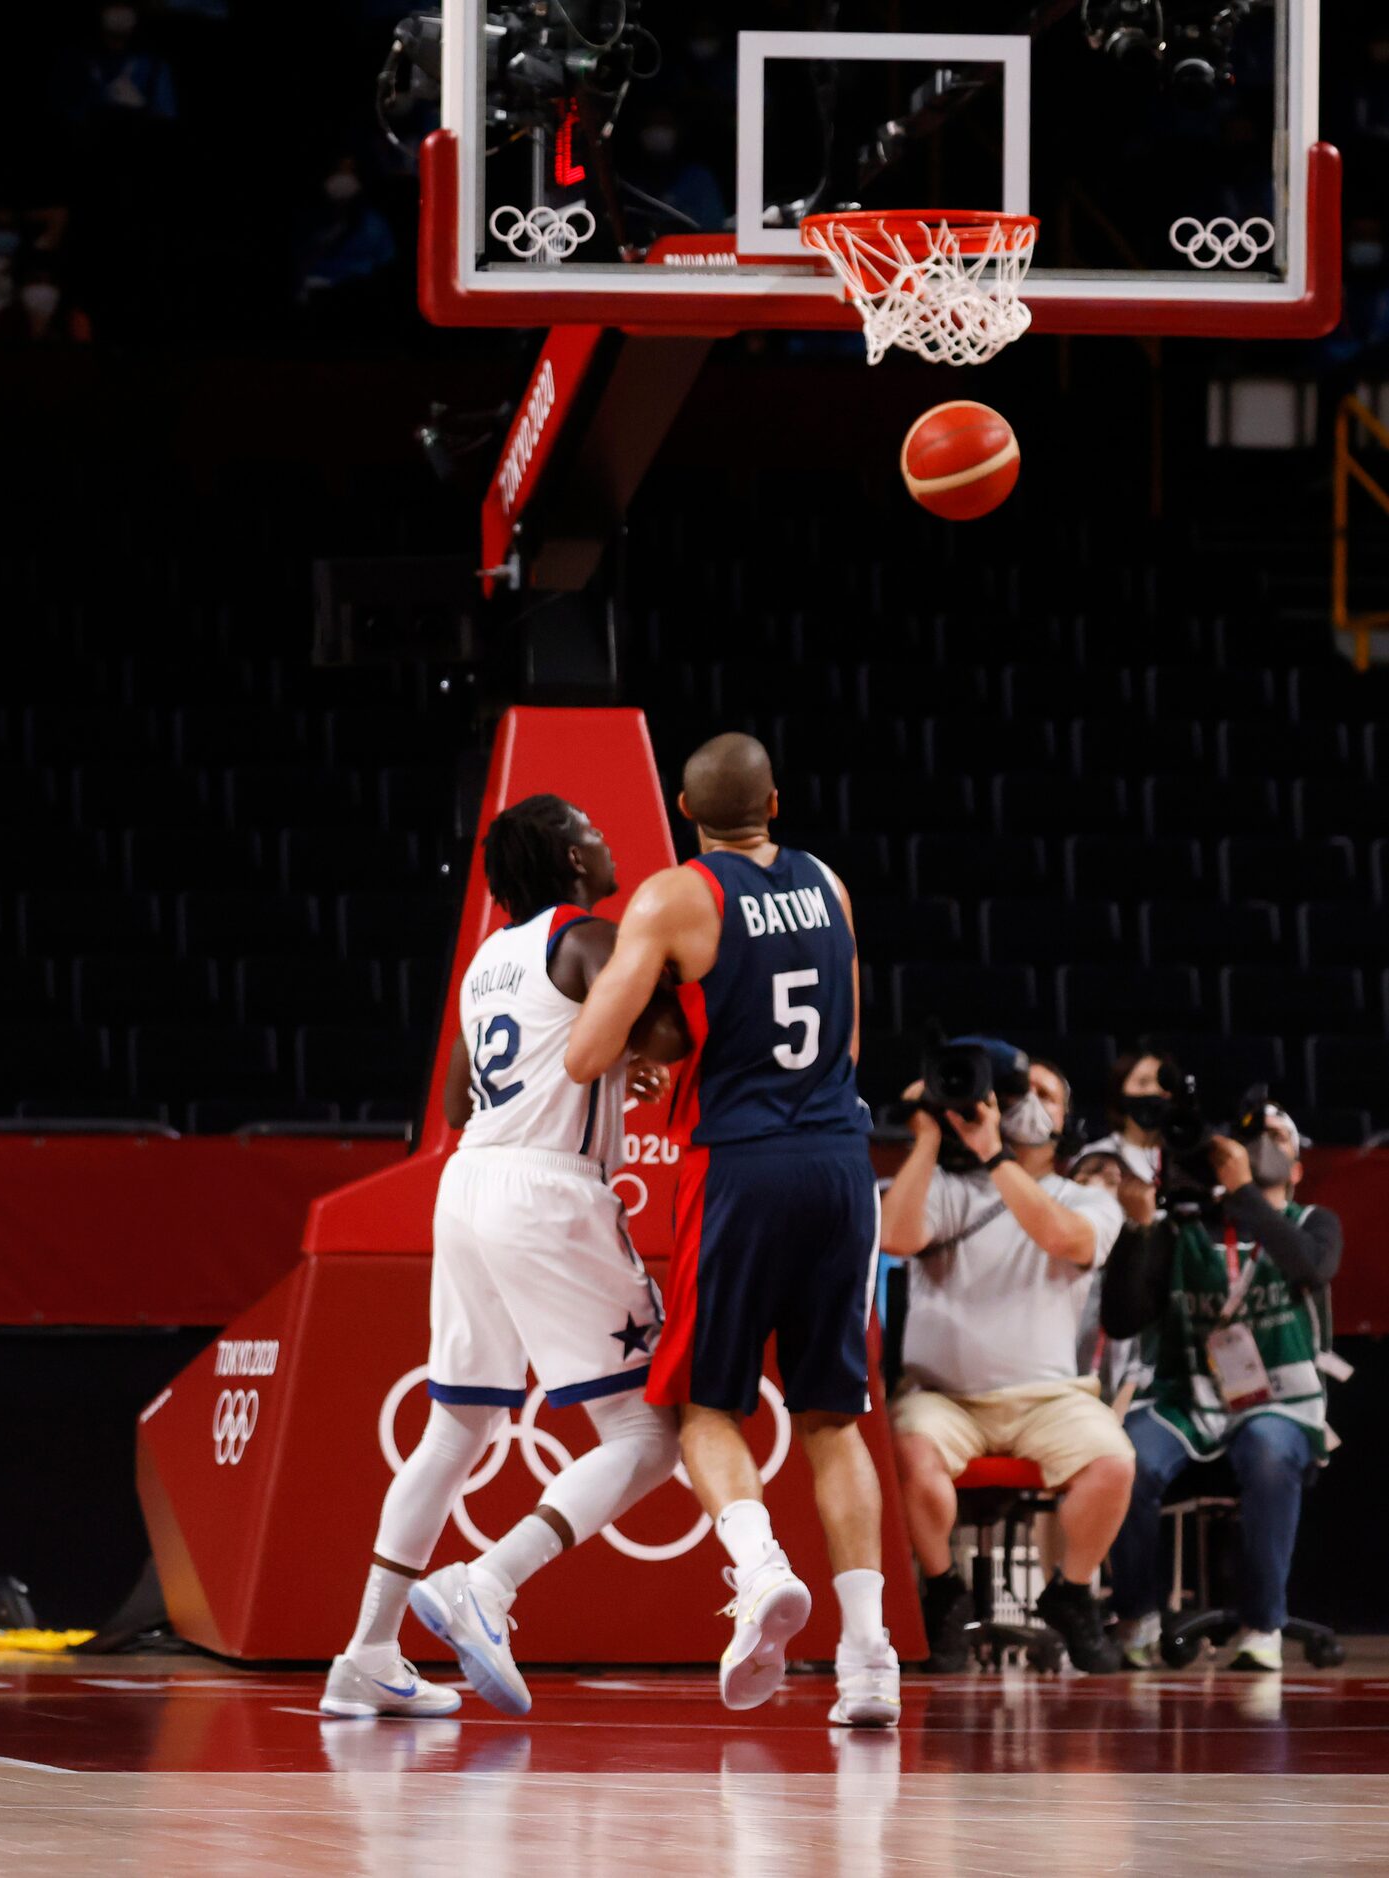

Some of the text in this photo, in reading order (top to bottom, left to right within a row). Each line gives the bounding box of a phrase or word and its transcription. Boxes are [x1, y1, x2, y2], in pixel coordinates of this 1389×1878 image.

[738, 886, 831, 938] BATUM
[470, 961, 526, 1004] HOLIDAY
[771, 967, 821, 1071] 5
